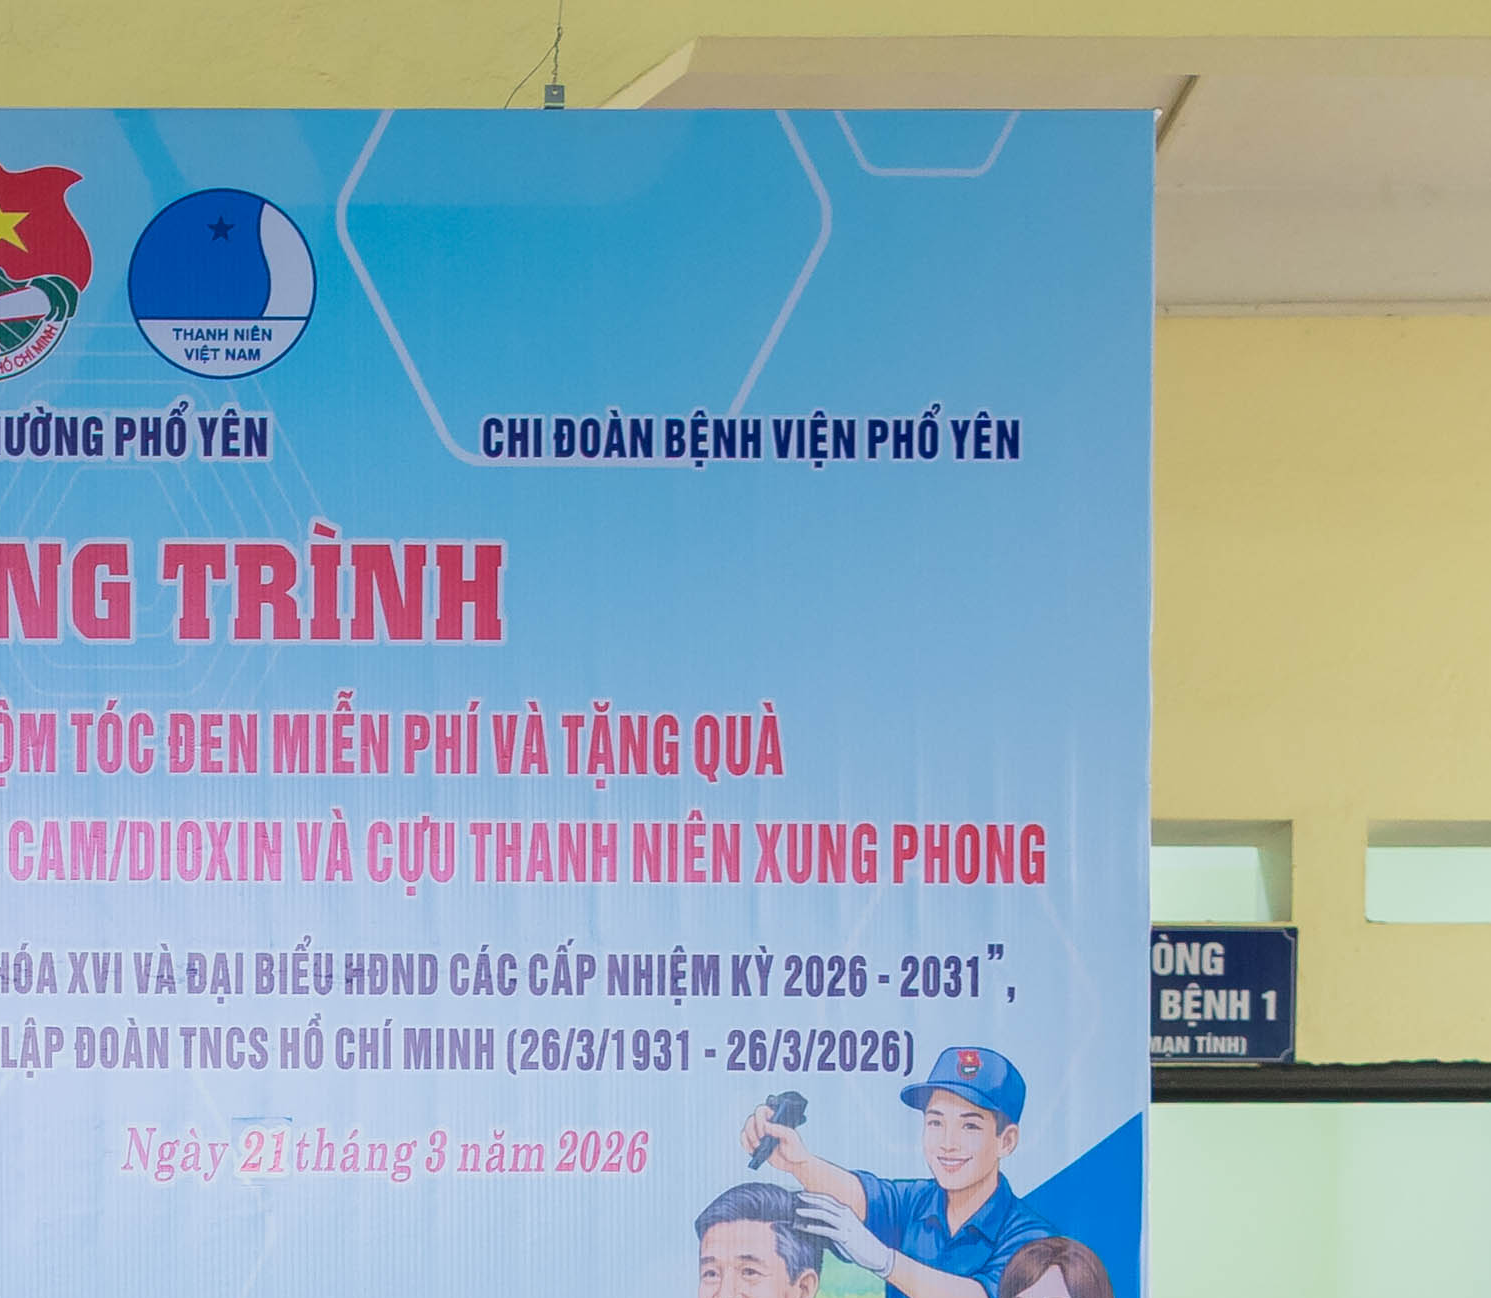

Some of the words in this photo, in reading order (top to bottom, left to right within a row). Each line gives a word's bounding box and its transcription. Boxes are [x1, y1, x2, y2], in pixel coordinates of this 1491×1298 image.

[34, 324, 58, 354] MINH
[173, 328, 229, 342] THANH
[234, 325, 272, 342] NIÊN
[184, 347, 220, 364] VIỆT
[225, 348, 260, 361] NAM
[115, 401, 189, 456] PHỔ
[198, 407, 268, 457] YÊN
[483, 417, 542, 458] CHI
[553, 409, 653, 458] ĐOÀN
[665, 410, 761, 467] BỆNH
[773, 411, 855, 468] VIỆN
[867, 403, 942, 459] PHỔ
[951, 411, 1020, 459] YÊN
[163, 523, 502, 641] TRÌNH
[71, 701, 153, 773] TÓC
[169, 713, 257, 774] ĐEN
[273, 690, 389, 774] MIỄN
[405, 702, 480, 775] PHÍ
[493, 702, 549, 776] VÀ
[562, 701, 679, 789] TẶNG
[695, 702, 784, 782] QUÀ
[9, 819, 282, 882] CAM/DIOXIN
[297, 808, 353, 882] VÀ
[368, 815, 456, 897] CỰU
[470, 822, 617, 884] THANH
[633, 810, 741, 884] NIÊN
[754, 823, 878, 884] XUNG
[894, 823, 1046, 884] PHONG
[67, 952, 122, 994] XVI
[134, 942, 175, 995] VÀ
[187, 952, 244, 1004] ĐẠI
[258, 935, 334, 995] BIỂU
[345, 952, 438, 997] HĐND
[449, 945, 518, 996] CÁC
[528, 939, 597, 996] CẤP
[608, 945, 718, 1006] NHIỆM
[732, 946, 770, 997] KỲ
[784, 953, 868, 997] 2026
[878, 974, 890, 984] -
[1160, 983, 1250, 1027] BỆNH
[1262, 990, 1276, 1021] 1
[0, 1018, 65, 1078] LẬP
[75, 1017, 169, 1070] ĐOÀN
[180, 1026, 268, 1070] TNCS
[280, 1009, 325, 1070] HỒ
[334, 1018, 391, 1071] CHÍ
[403, 1028, 495, 1071] MINH
[507, 1028, 691, 1075] (26/3/1931
[704, 1049, 717, 1059] -
[727, 1029, 914, 1075] 26/3/2026)
[1195, 1032, 1247, 1055] TÍNH)
[122, 1127, 230, 1182] Ngày
[240, 1129, 286, 1172] 21
[296, 1127, 418, 1182] tháng
[425, 1131, 448, 1172] 3
[457, 1131, 545, 1172] năm
[555, 1130, 649, 1173] 2026
